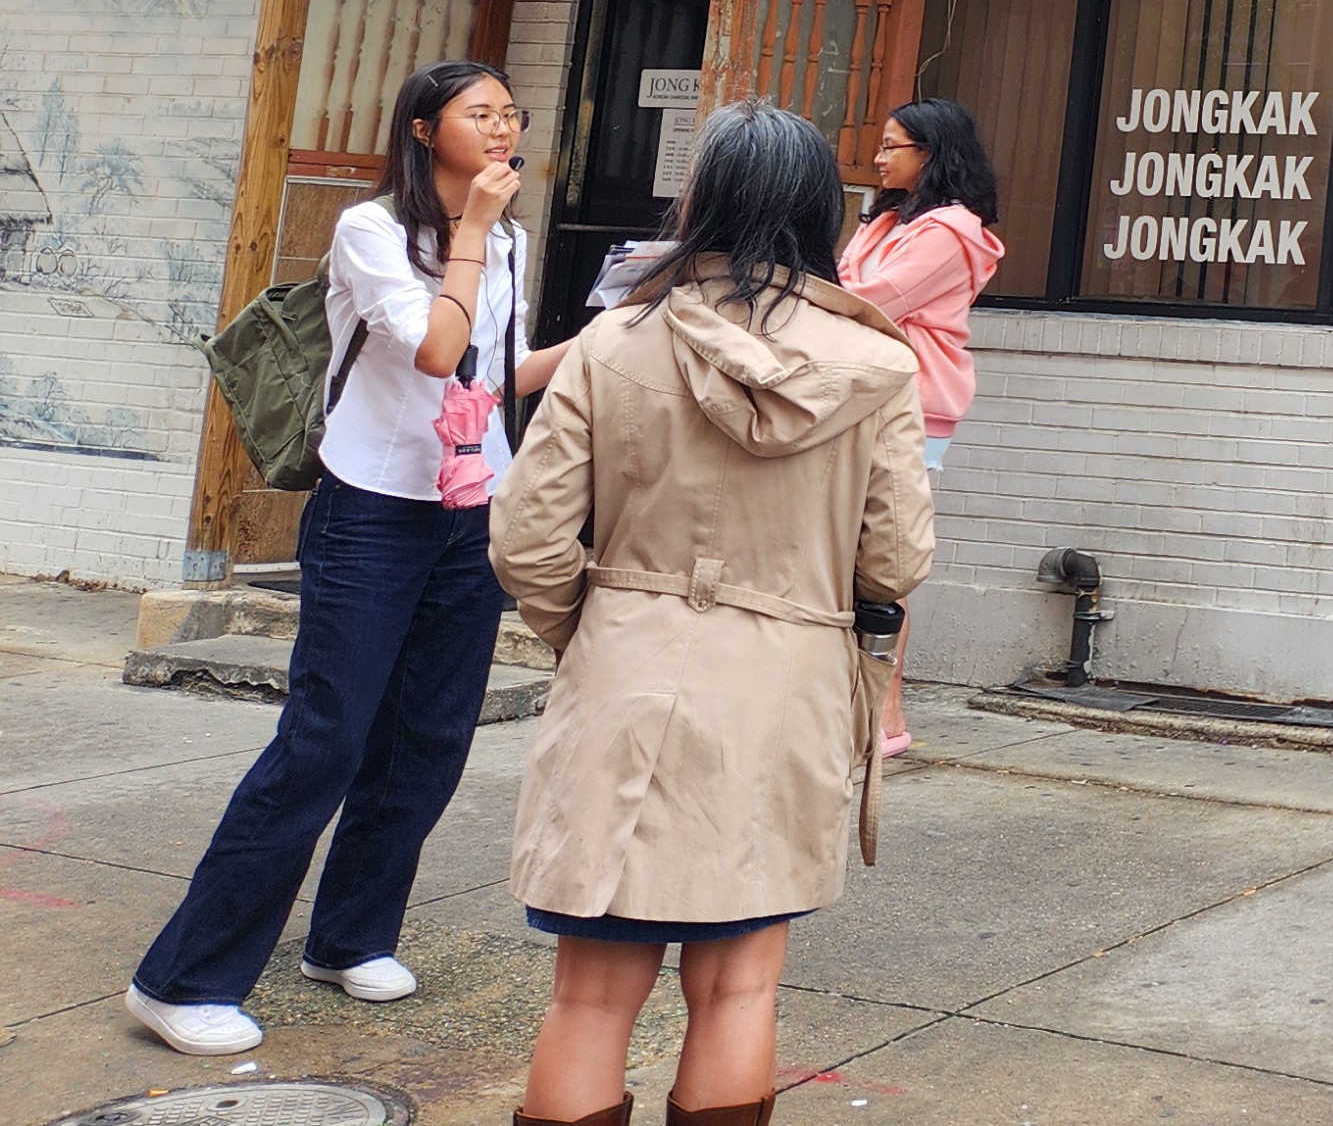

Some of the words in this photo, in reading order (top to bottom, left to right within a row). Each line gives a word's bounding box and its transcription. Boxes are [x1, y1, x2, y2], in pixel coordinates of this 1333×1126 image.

[646, 77, 690, 99] JONG
[1116, 88, 1320, 136] JONGKAK
[1110, 151, 1315, 201] JONGKAK
[1103, 215, 1309, 266] JONGKAK
